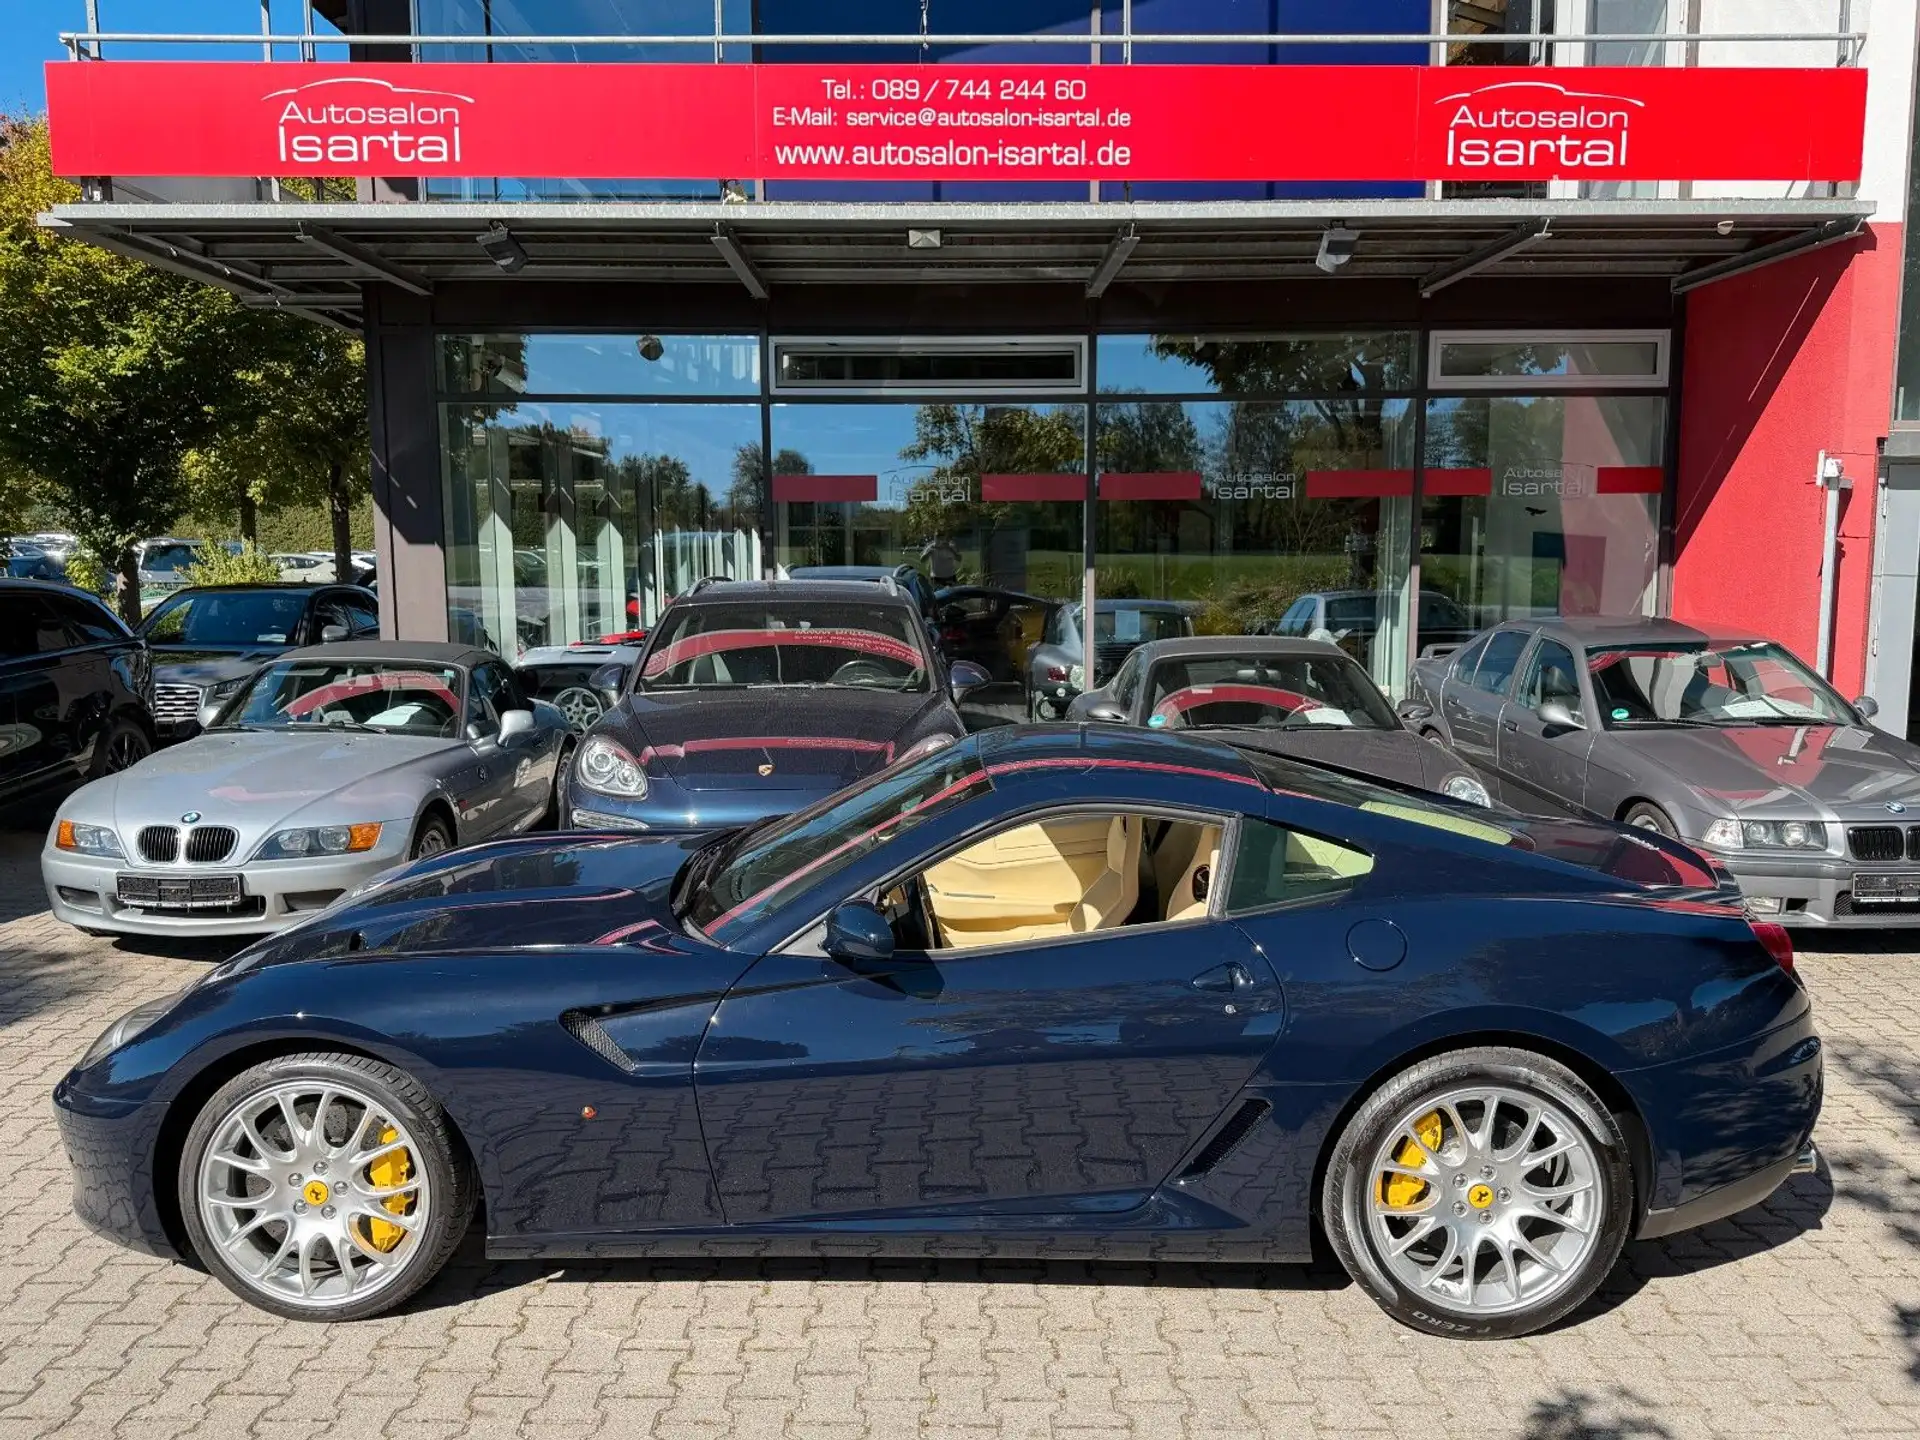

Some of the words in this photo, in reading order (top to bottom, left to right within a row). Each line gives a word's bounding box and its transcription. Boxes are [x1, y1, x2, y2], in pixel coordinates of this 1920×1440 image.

[821, 79, 865, 100] Tel.:
[872, 79, 920, 100] 089
[922, 79, 940, 102] /
[945, 79, 992, 100] 744
[1000, 79, 1046, 100] 244
[1054, 79, 1086, 100] 60
[279, 100, 459, 124] Autosalon
[773, 107, 838, 126] E-Mail:
[846, 107, 1131, 127] service@autosalon-isartal.de
[1450, 105, 1629, 128] Autosalon
[278, 126, 461, 162] Isartal
[774, 139, 1131, 166] www.autosalon-isartal.de
[1447, 129, 1628, 166] Isartal
[1213, 472, 1296, 482] Autosalon
[1503, 467, 1581, 479] Autosa
[889, 485, 971, 501] Isartal
[1212, 482, 1296, 499] Isartal
[1502, 478, 1587, 496] Isartal
